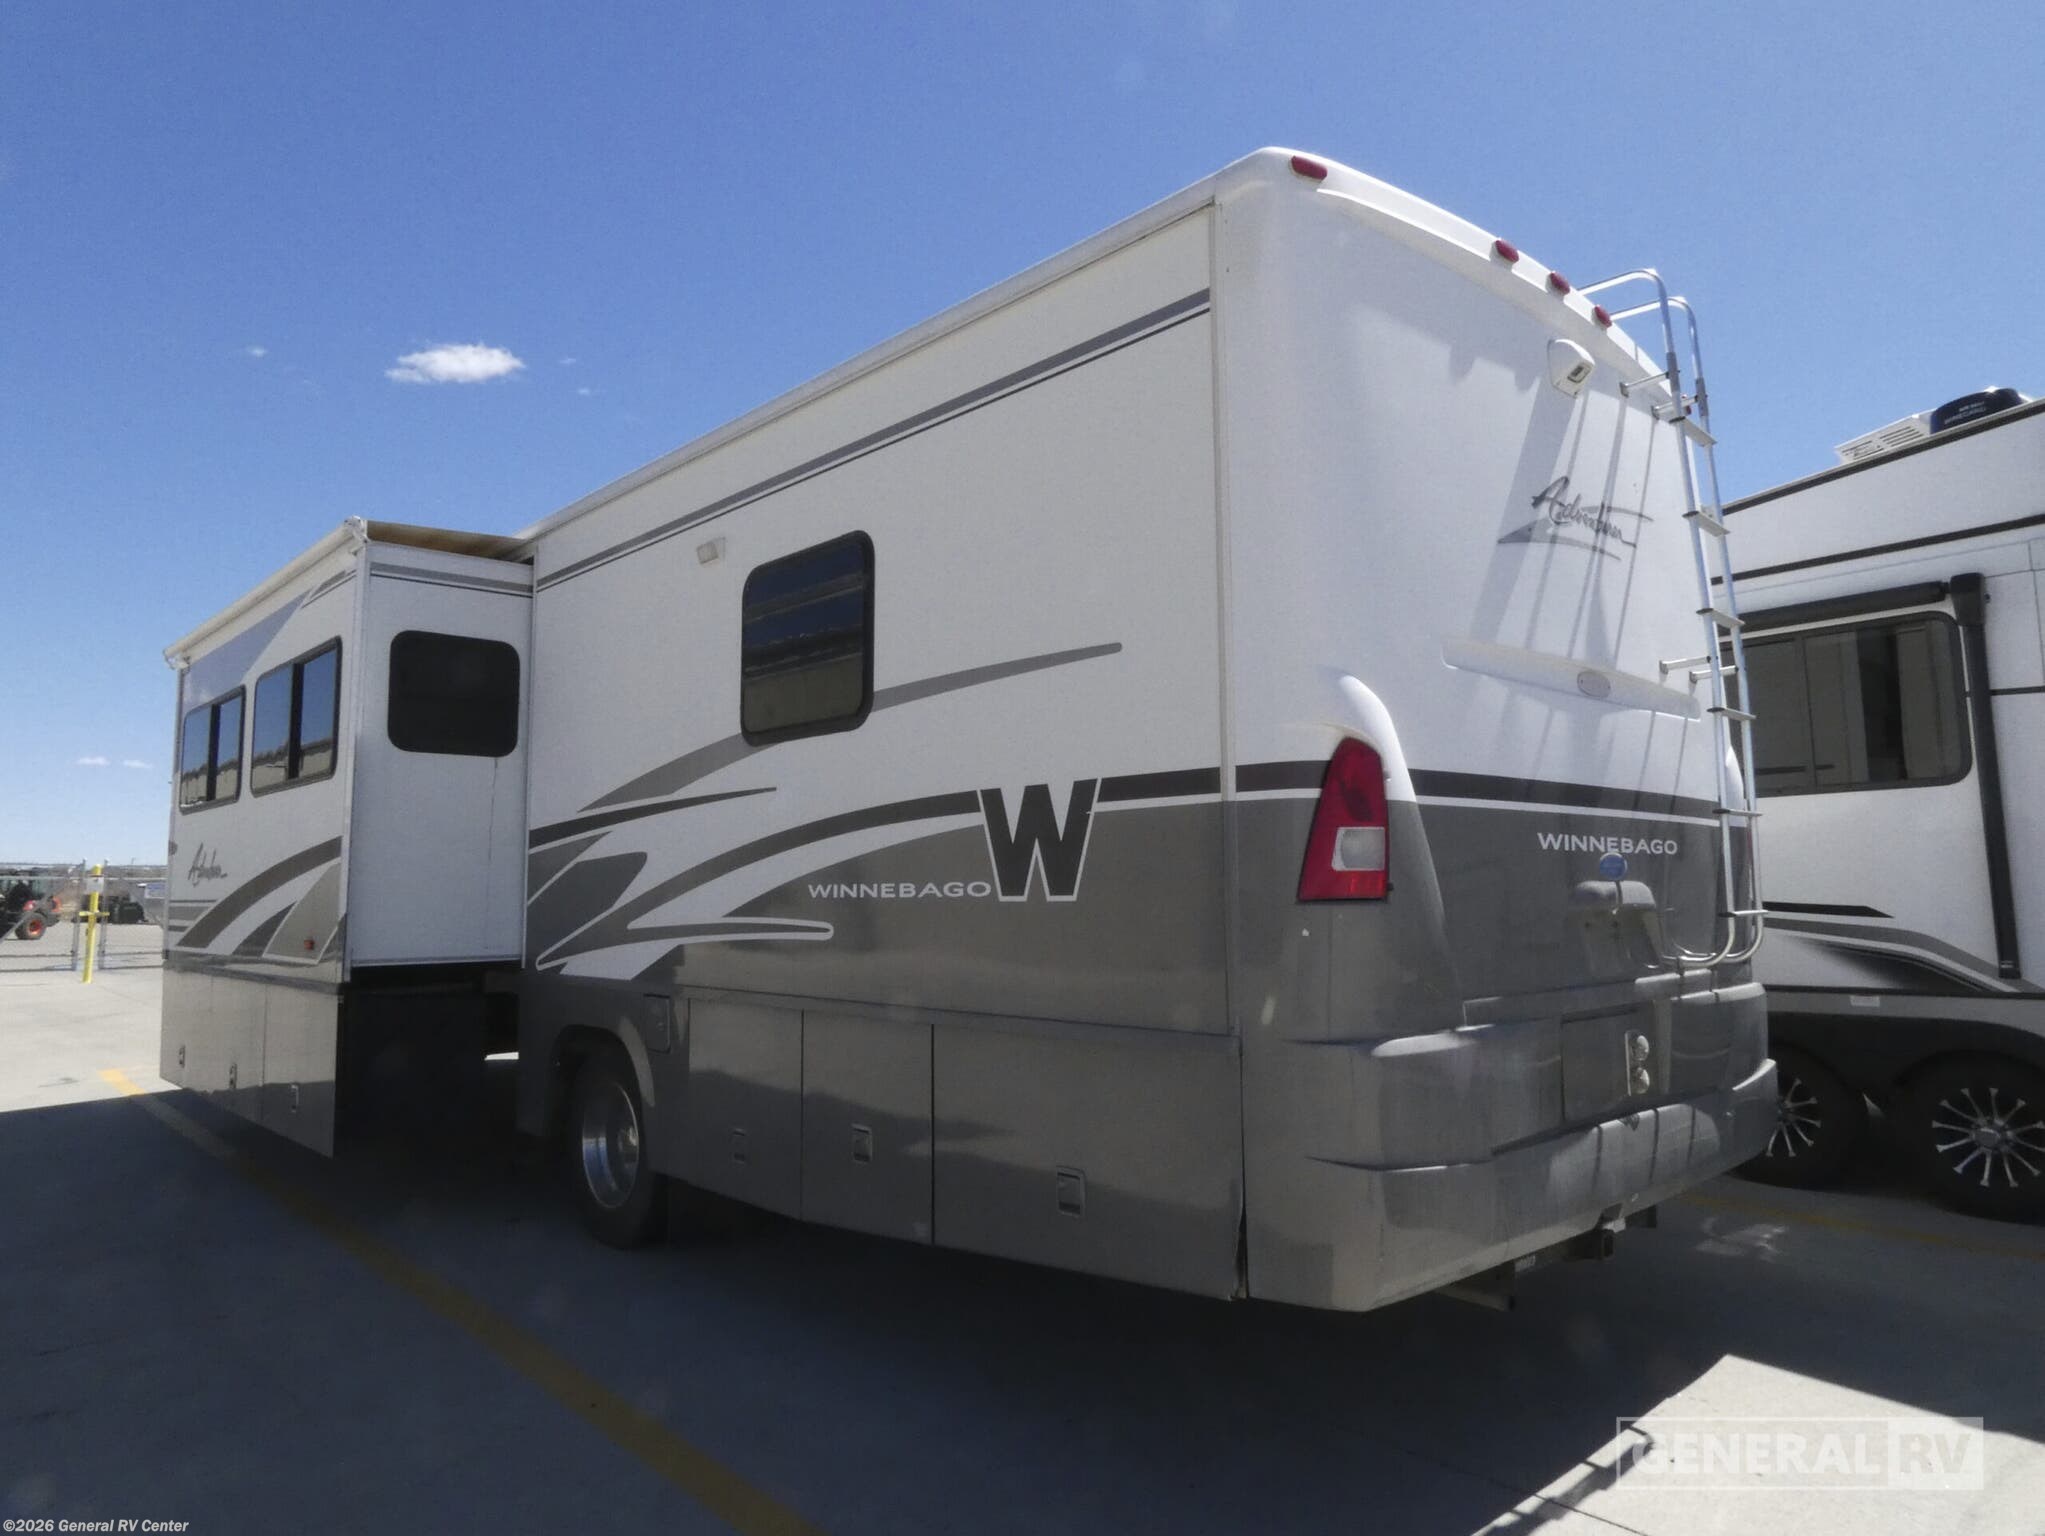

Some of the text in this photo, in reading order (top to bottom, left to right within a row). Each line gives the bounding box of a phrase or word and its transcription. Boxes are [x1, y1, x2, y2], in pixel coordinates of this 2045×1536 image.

[977, 778, 1102, 902] W
[1537, 832, 1678, 855] WINNEBAGO
[807, 881, 992, 899] WINNEBAGO
